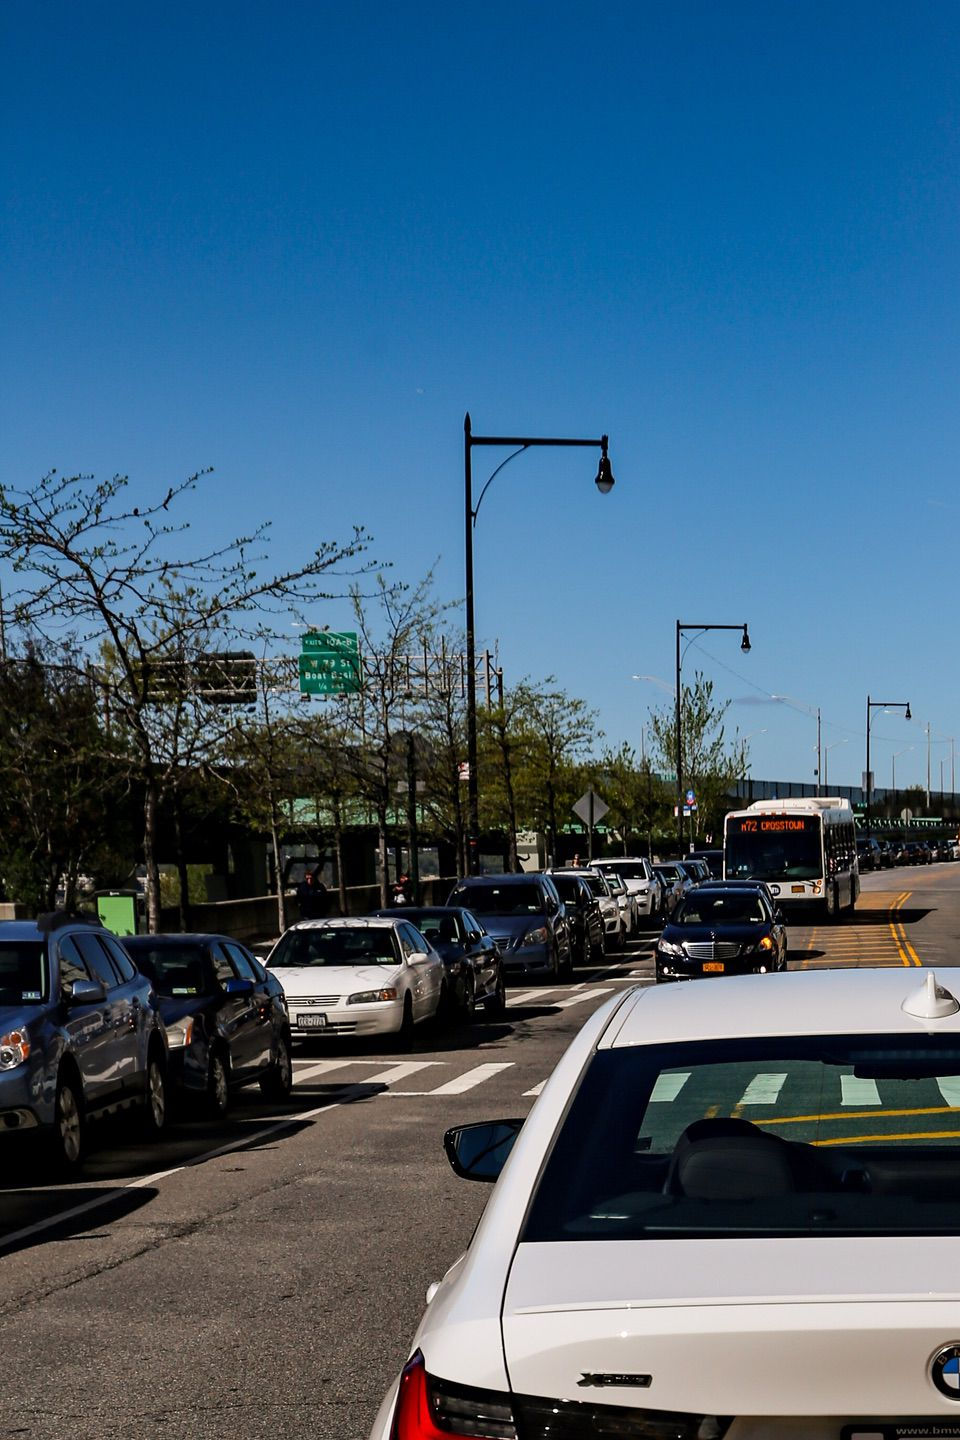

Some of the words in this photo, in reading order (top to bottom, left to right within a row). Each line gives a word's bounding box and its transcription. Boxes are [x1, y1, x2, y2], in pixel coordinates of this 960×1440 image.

[340, 659, 351, 667] St
[305, 672, 327, 680] Boat
[761, 820, 805, 831] CROSSTOWN
